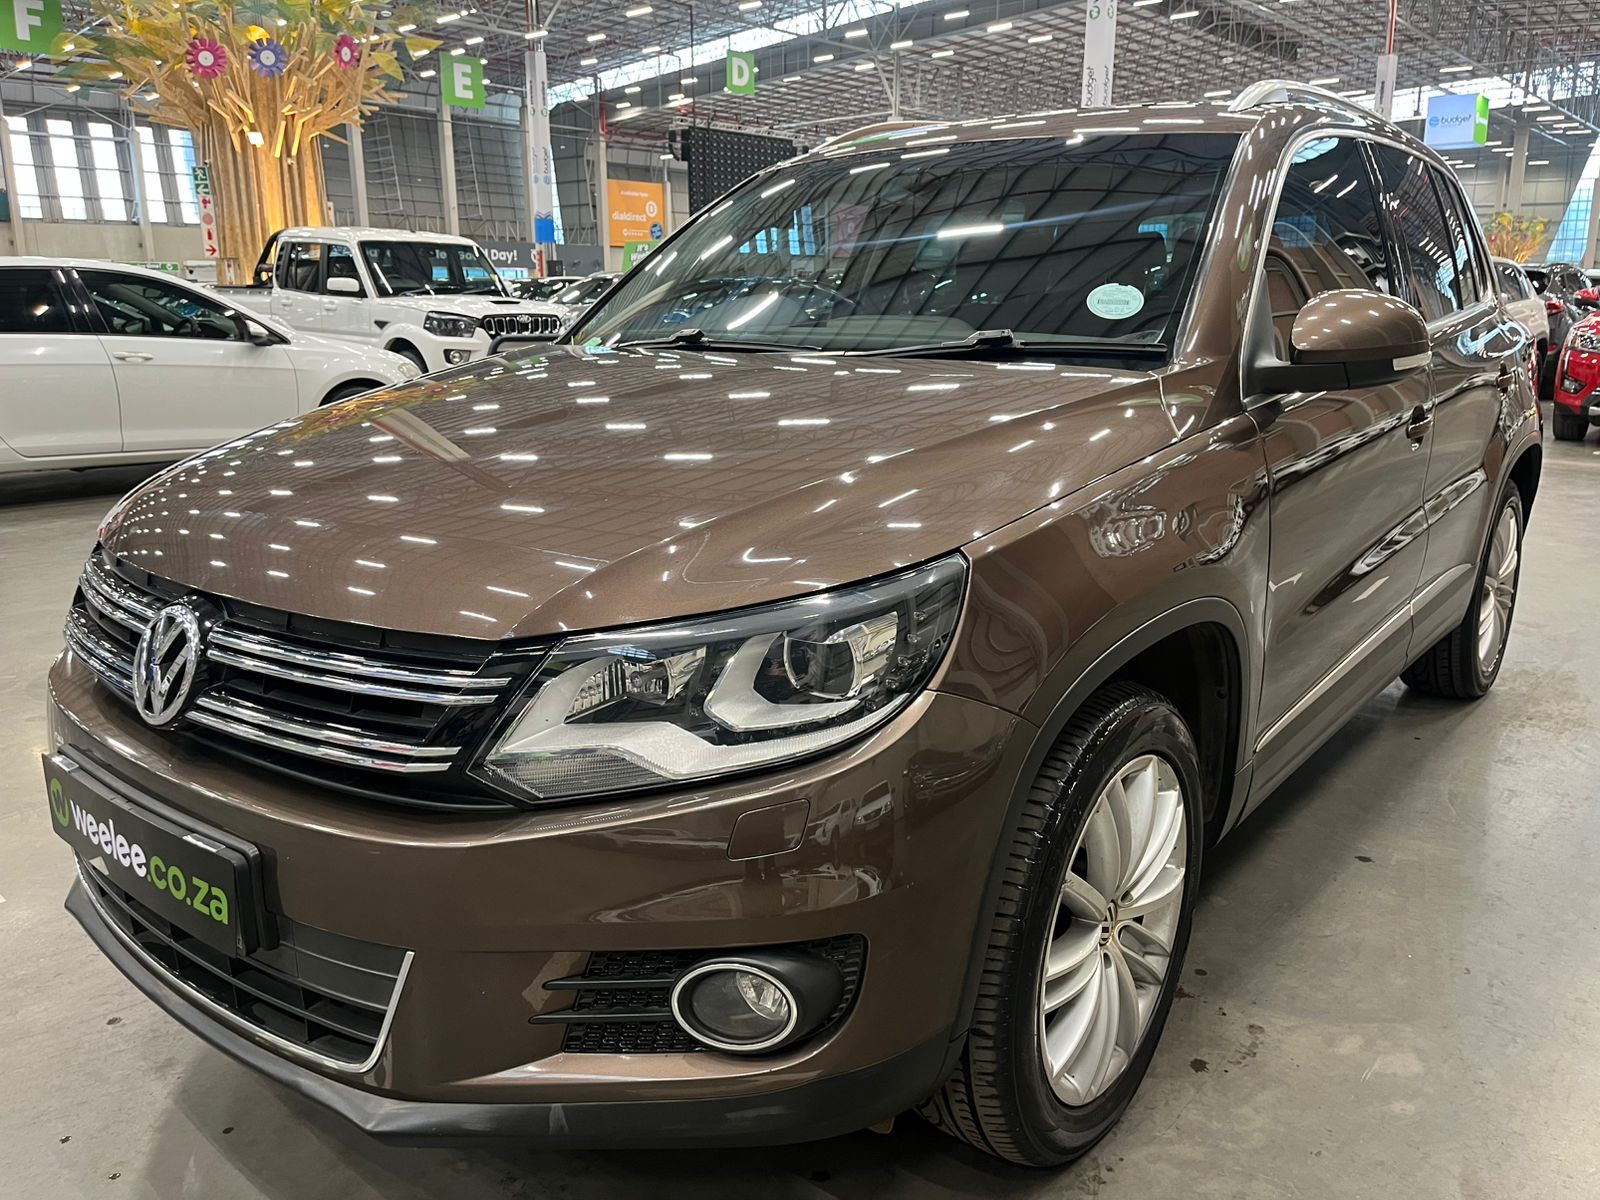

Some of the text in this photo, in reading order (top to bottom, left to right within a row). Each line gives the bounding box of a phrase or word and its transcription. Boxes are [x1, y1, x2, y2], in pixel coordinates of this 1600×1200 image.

[13, 0, 44, 41] F
[453, 62, 473, 99] E
[732, 56, 749, 86] D
[1087, 66, 1097, 106] budget
[1441, 114, 1472, 124] budget
[612, 210, 647, 222] dialdirect
[490, 249, 518, 264] Day!
[70, 799, 229, 925] weelee.co.za
